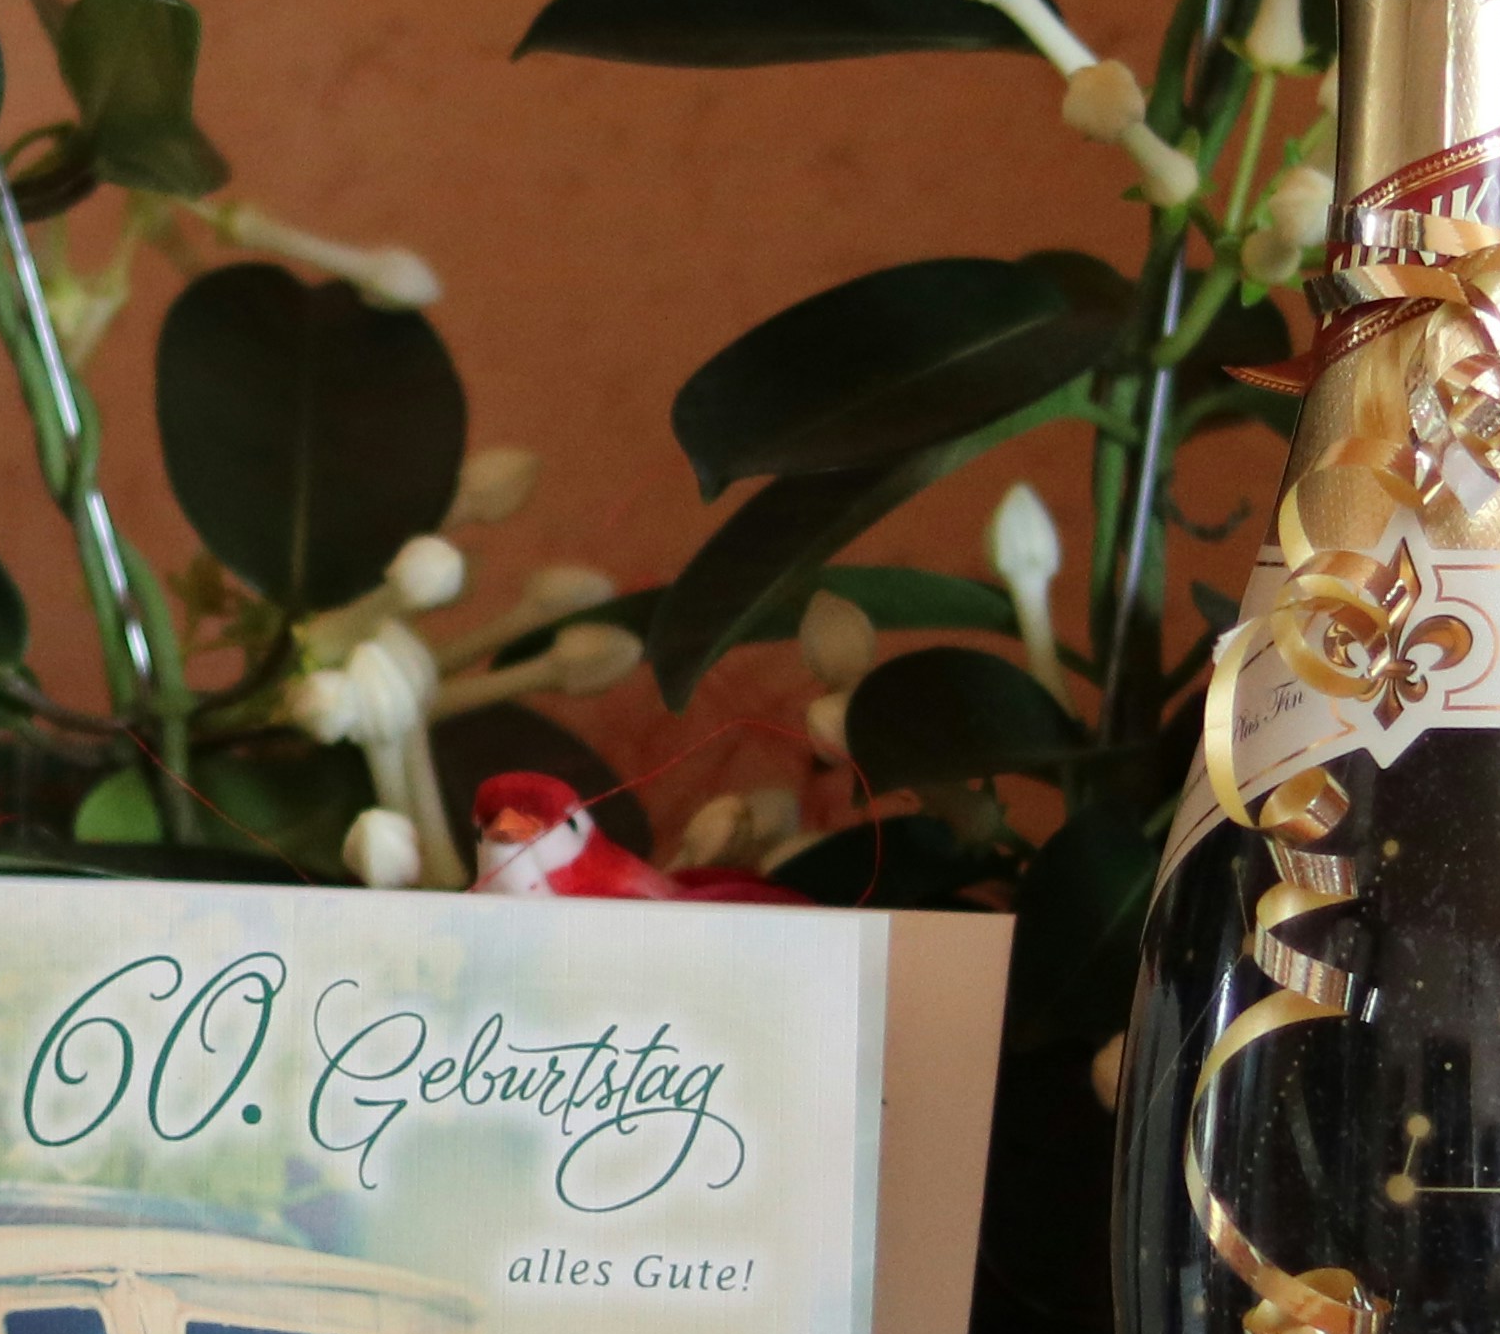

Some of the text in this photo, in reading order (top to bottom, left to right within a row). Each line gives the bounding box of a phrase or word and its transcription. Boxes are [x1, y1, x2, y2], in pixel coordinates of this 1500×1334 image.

[21, 951, 286, 1148] 60.
[308, 978, 747, 1214] Geburtstag
[507, 1247, 755, 1294] alles Gute!
